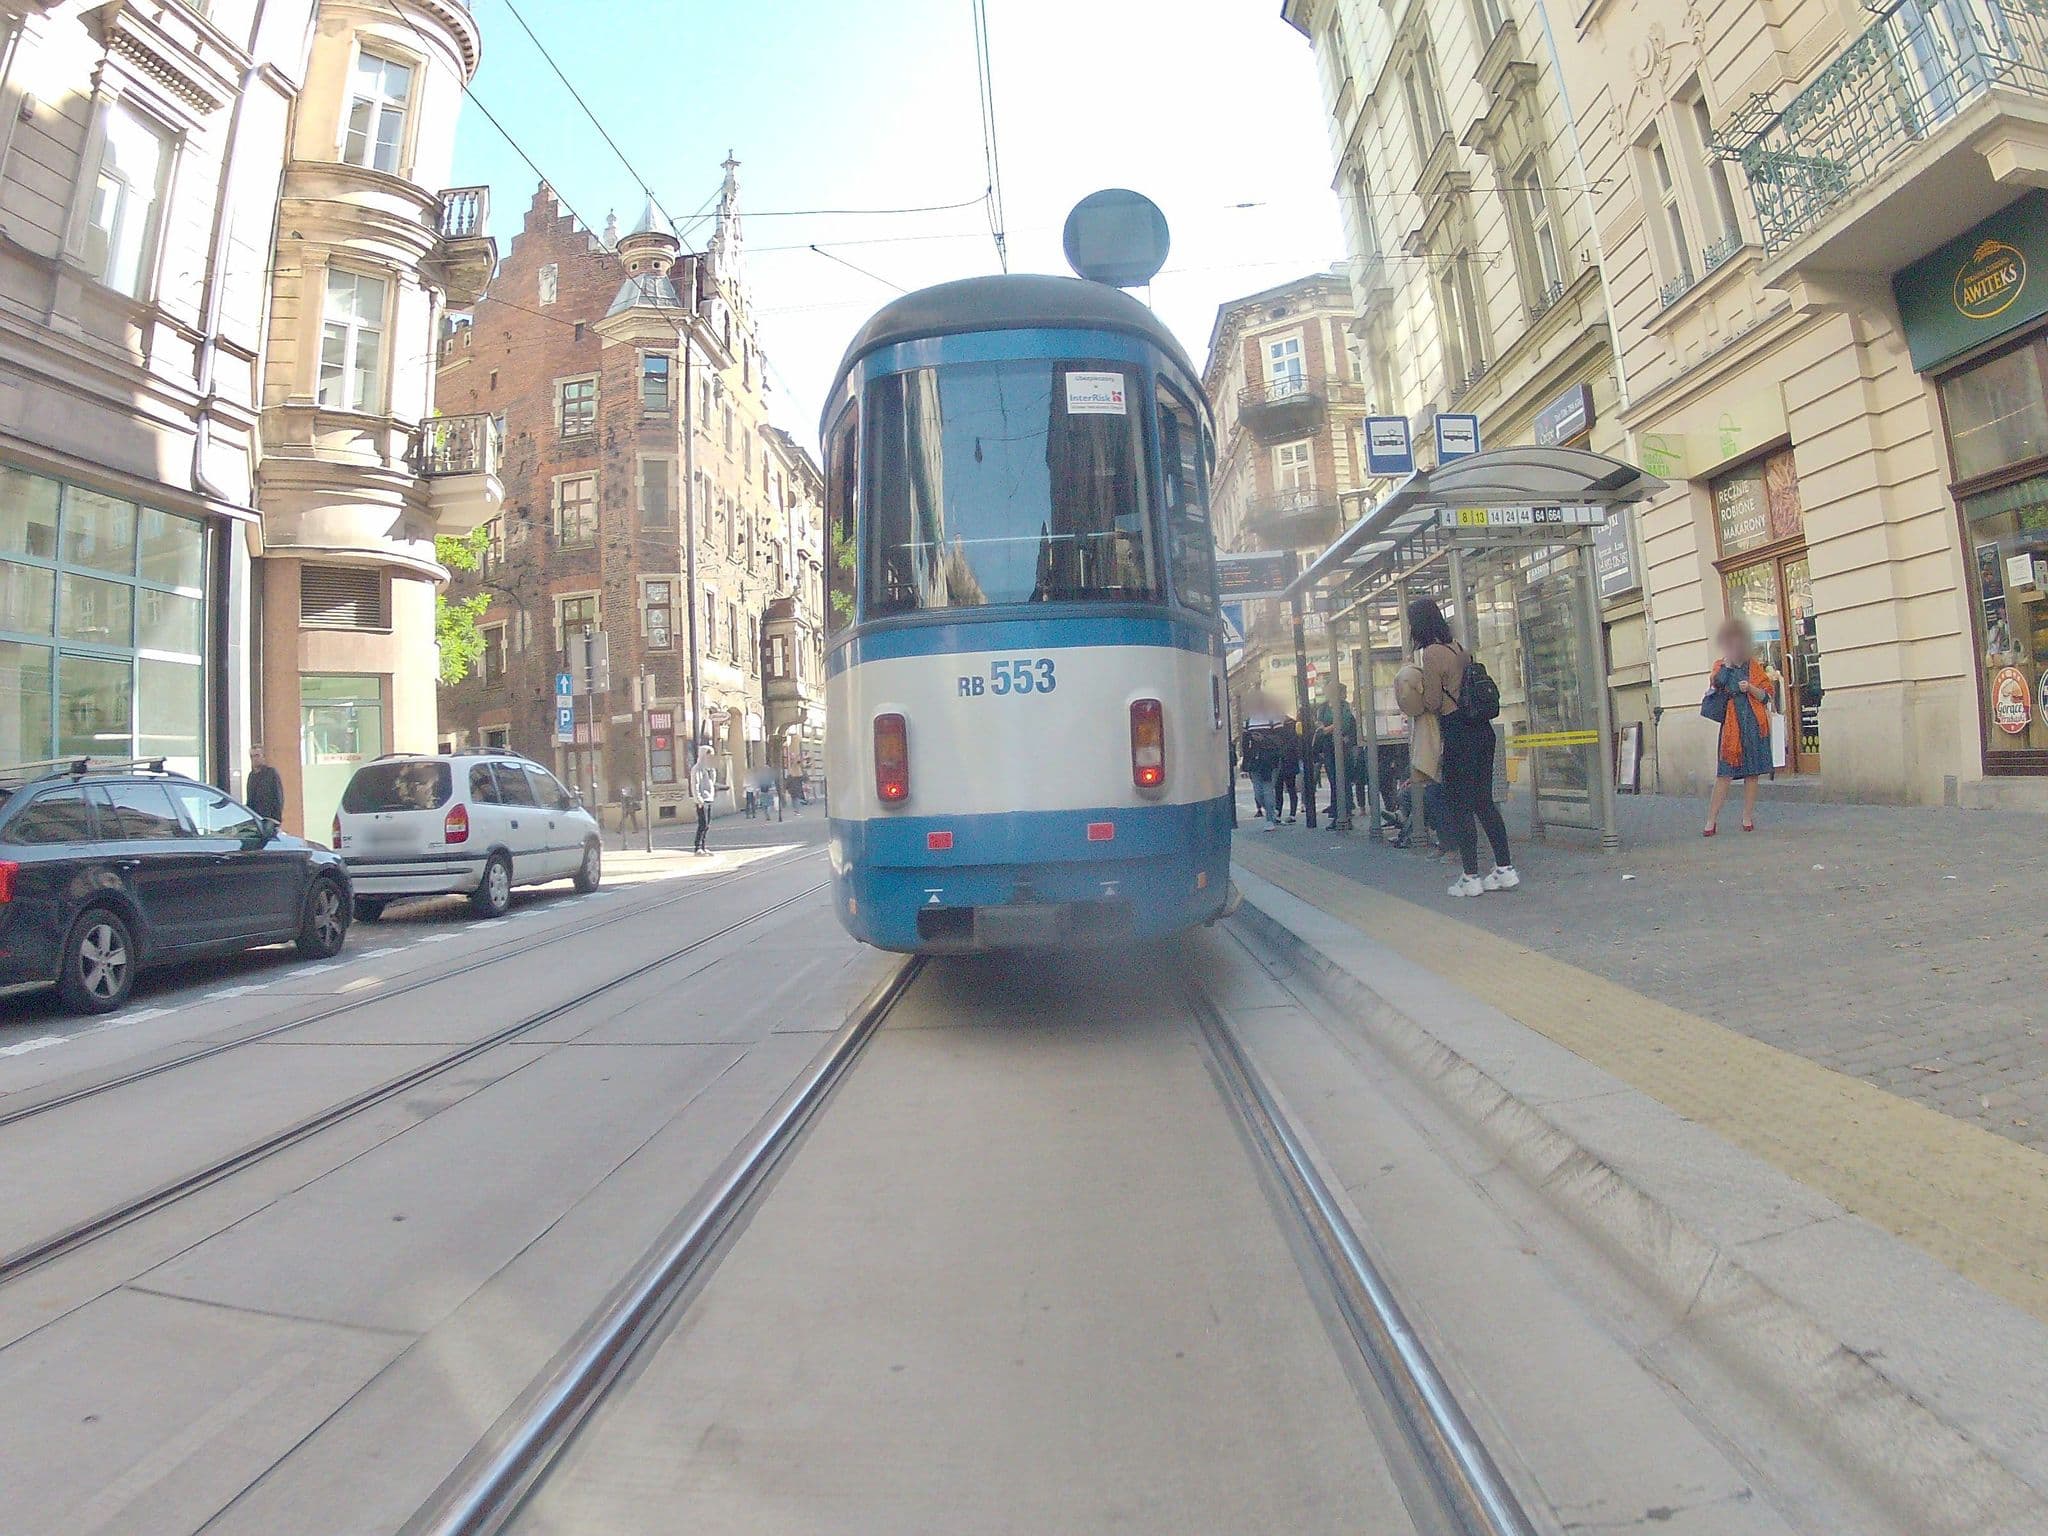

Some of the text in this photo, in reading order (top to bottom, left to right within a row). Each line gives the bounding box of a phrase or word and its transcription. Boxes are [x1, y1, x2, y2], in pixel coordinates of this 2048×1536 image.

[1963, 263, 2018, 307] AWITEKS
[1070, 393, 1111, 402] InterRisk
[1718, 480, 1750, 504] RĘCZNIE
[1462, 512, 1468, 523] 8
[1476, 512, 1485, 523] 13
[1491, 511, 1500, 522] 14
[1506, 511, 1515, 522] 24
[1521, 510, 1529, 521] 44
[1535, 510, 1545, 521] 64
[1720, 498, 1756, 522] ROBIONE
[1723, 514, 1766, 541] MAKARONY
[958, 658, 1057, 697] RB 553
[560, 709, 571, 726] P
